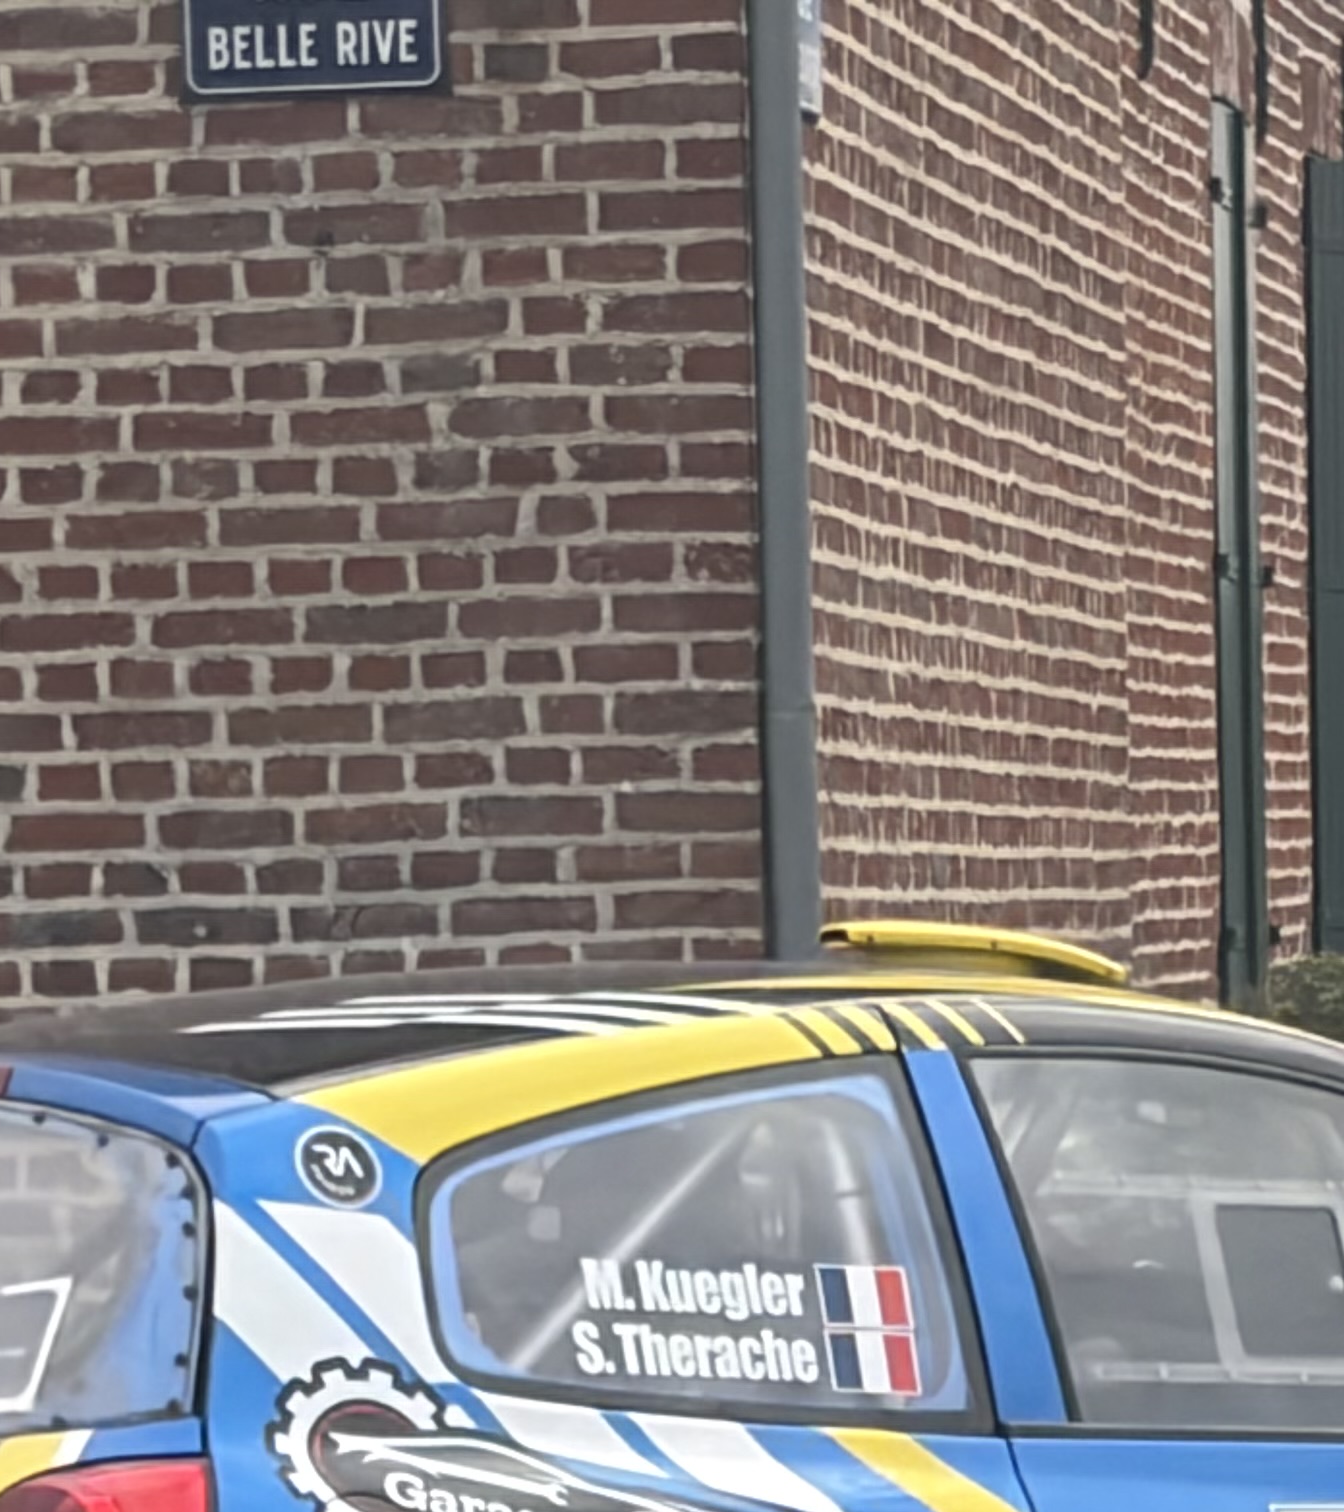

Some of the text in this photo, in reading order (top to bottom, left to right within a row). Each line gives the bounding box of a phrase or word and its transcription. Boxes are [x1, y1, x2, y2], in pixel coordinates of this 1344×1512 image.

[208, 19, 418, 70] BELLE RIVE
[580, 1258, 803, 1321] M. Kuegler
[572, 1321, 819, 1383] S. Therache
